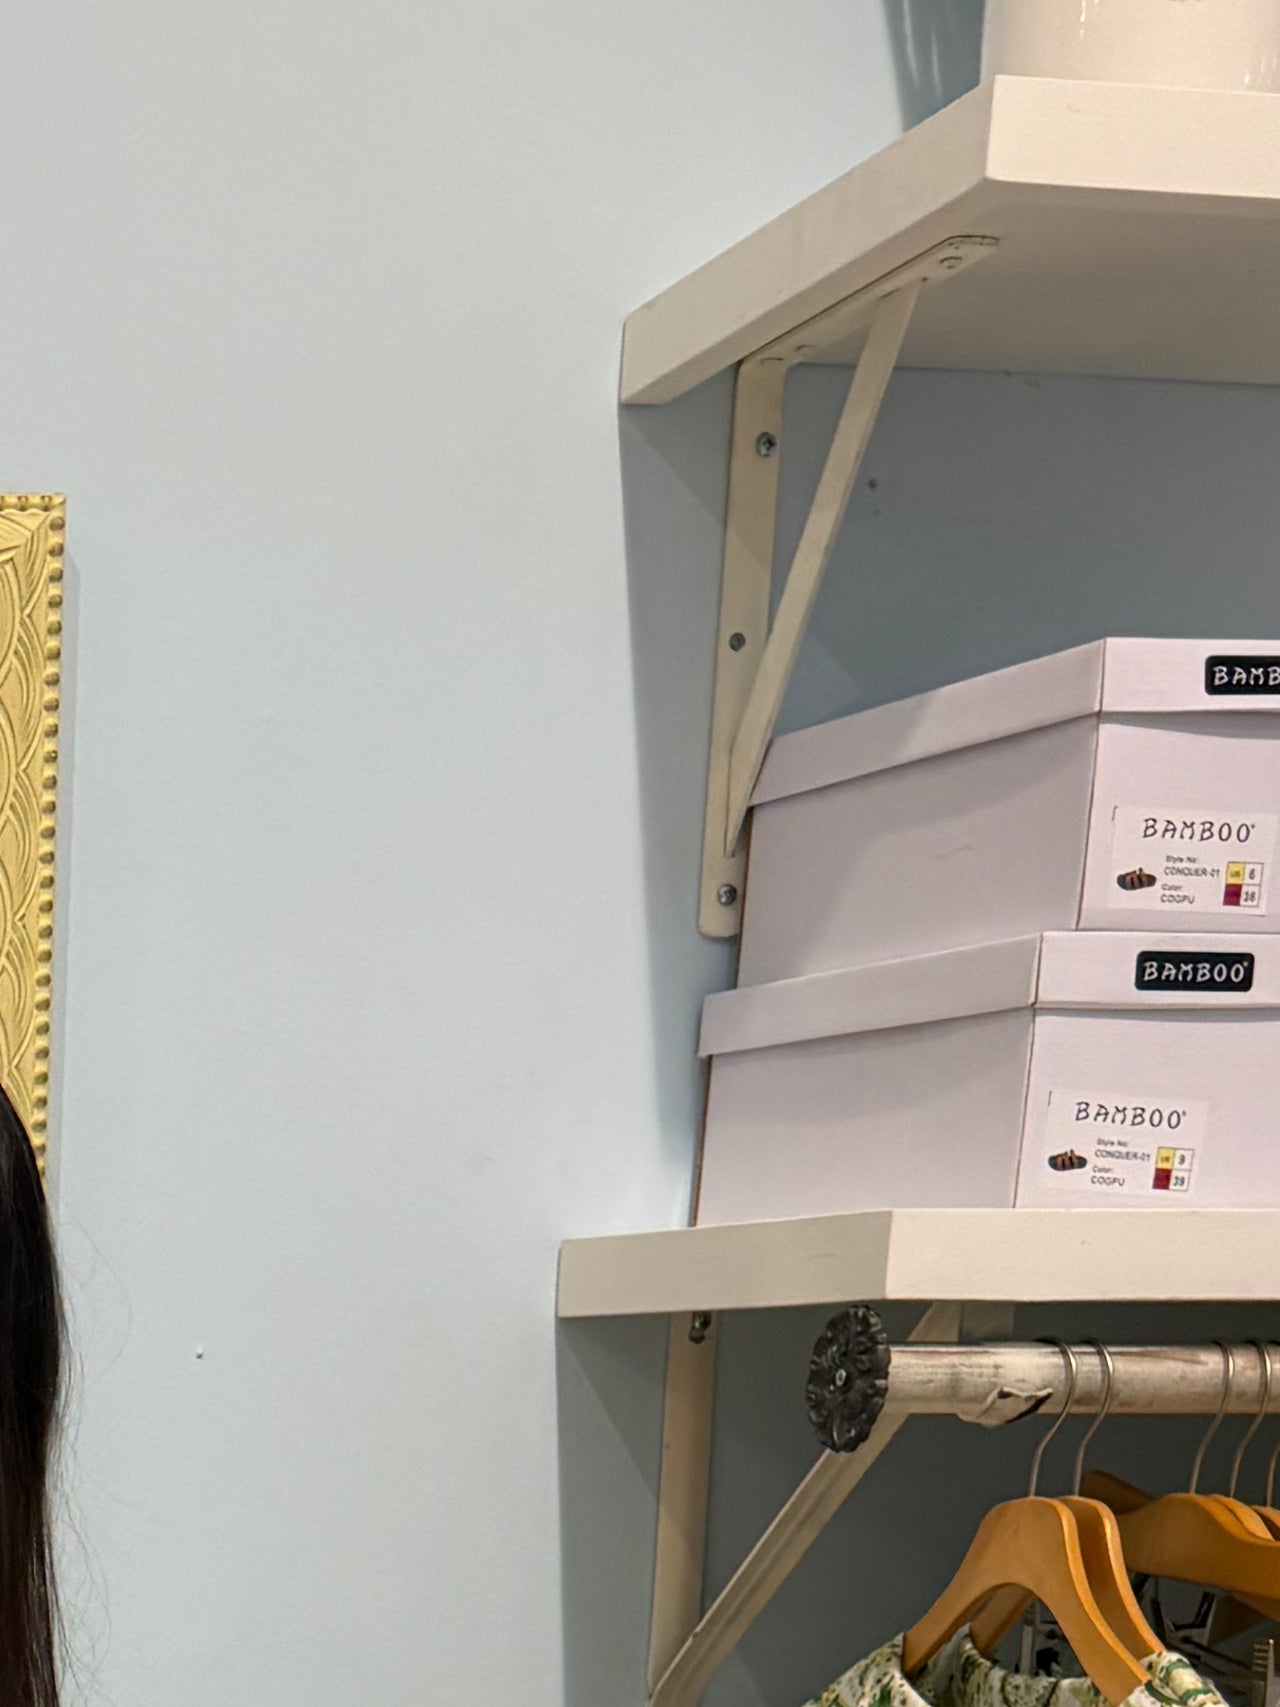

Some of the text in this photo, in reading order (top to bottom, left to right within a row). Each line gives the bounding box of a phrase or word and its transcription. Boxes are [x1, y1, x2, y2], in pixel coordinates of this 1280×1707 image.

[1142, 817, 1251, 843] BAMBOO
[1143, 961, 1245, 982] BAMBOO
[1075, 1101, 1181, 1129] BAMBOO
